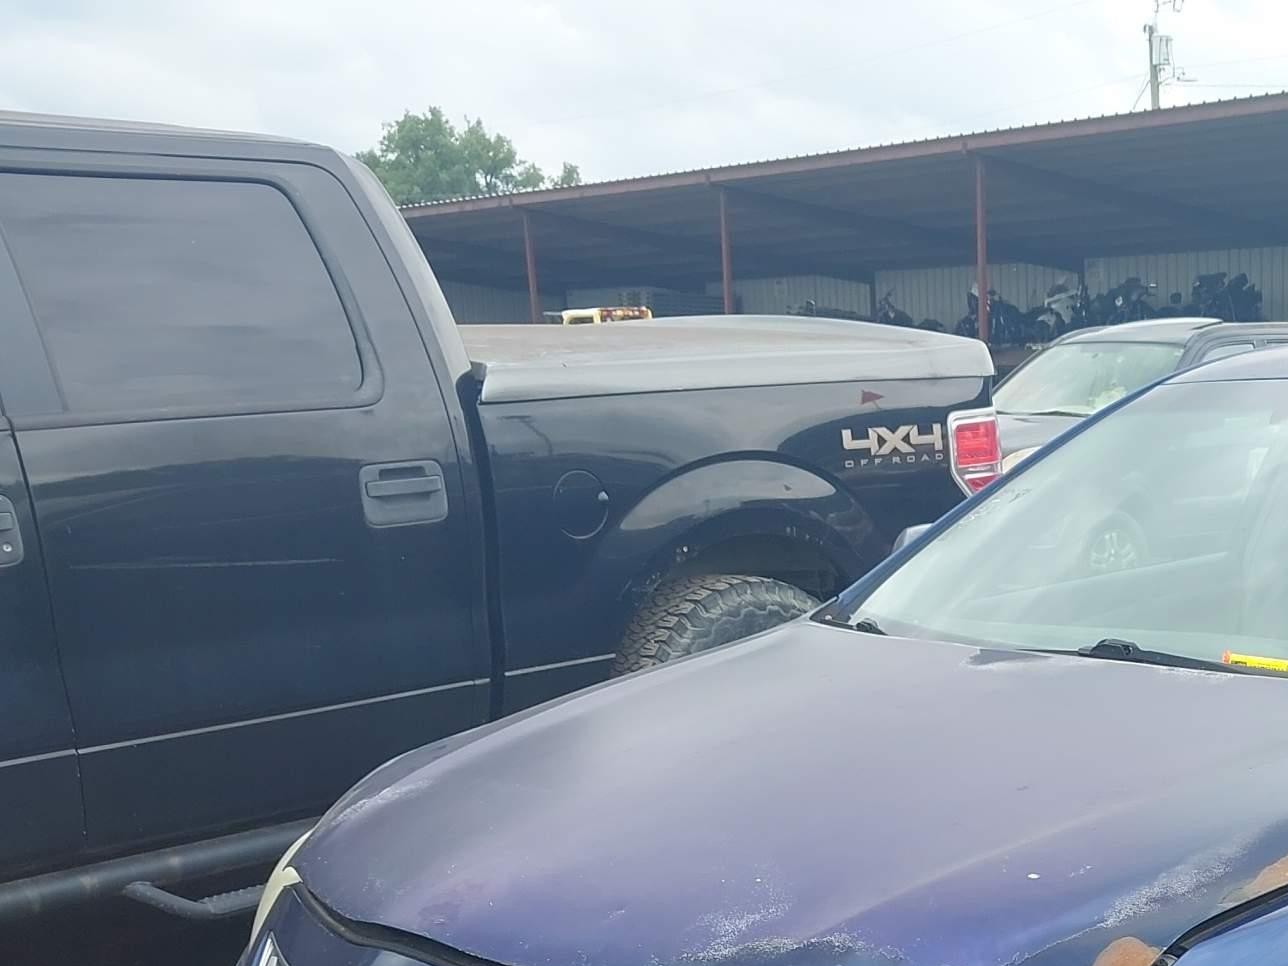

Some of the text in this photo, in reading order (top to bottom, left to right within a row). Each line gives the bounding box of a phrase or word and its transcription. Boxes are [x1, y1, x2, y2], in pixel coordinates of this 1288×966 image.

[841, 423, 943, 456] 4X4
[845, 453, 944, 468] OFF ROAD
